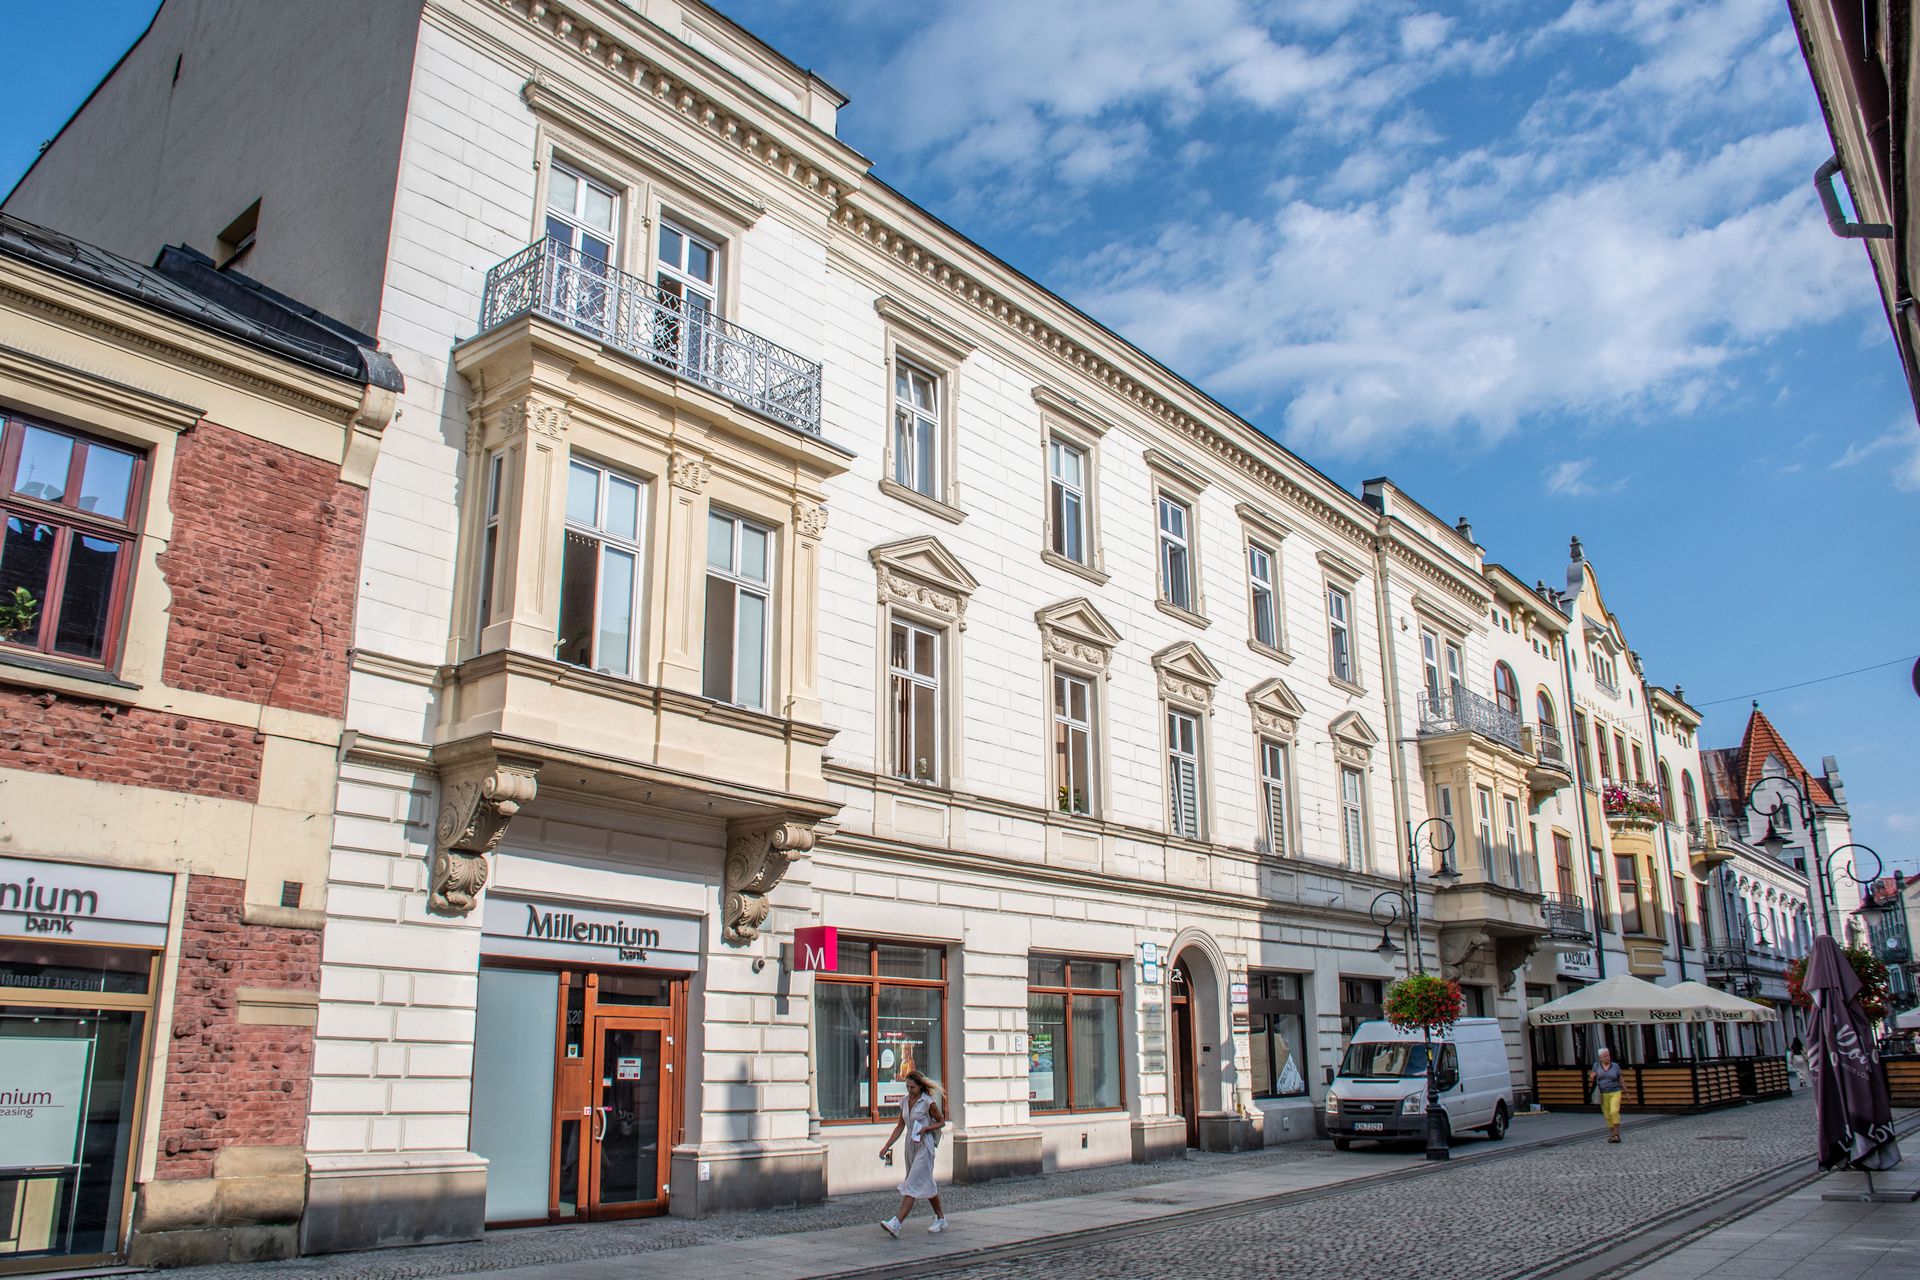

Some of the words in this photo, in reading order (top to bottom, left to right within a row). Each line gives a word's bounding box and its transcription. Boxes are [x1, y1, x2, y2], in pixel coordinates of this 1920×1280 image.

[0, 877, 98, 915] nium
[25, 912, 74, 934] bank
[526, 904, 660, 947] Millennium
[619, 946, 647, 962] bank
[804, 943, 825, 971] M
[1539, 1012, 1571, 1023] Kozel
[1593, 1009, 1624, 1020] Kozel
[1649, 1010, 1683, 1020] Kozel
[1721, 1011, 1744, 1021] ozel
[0, 1088, 52, 1105] nium
[0, 1107, 34, 1118] easing
